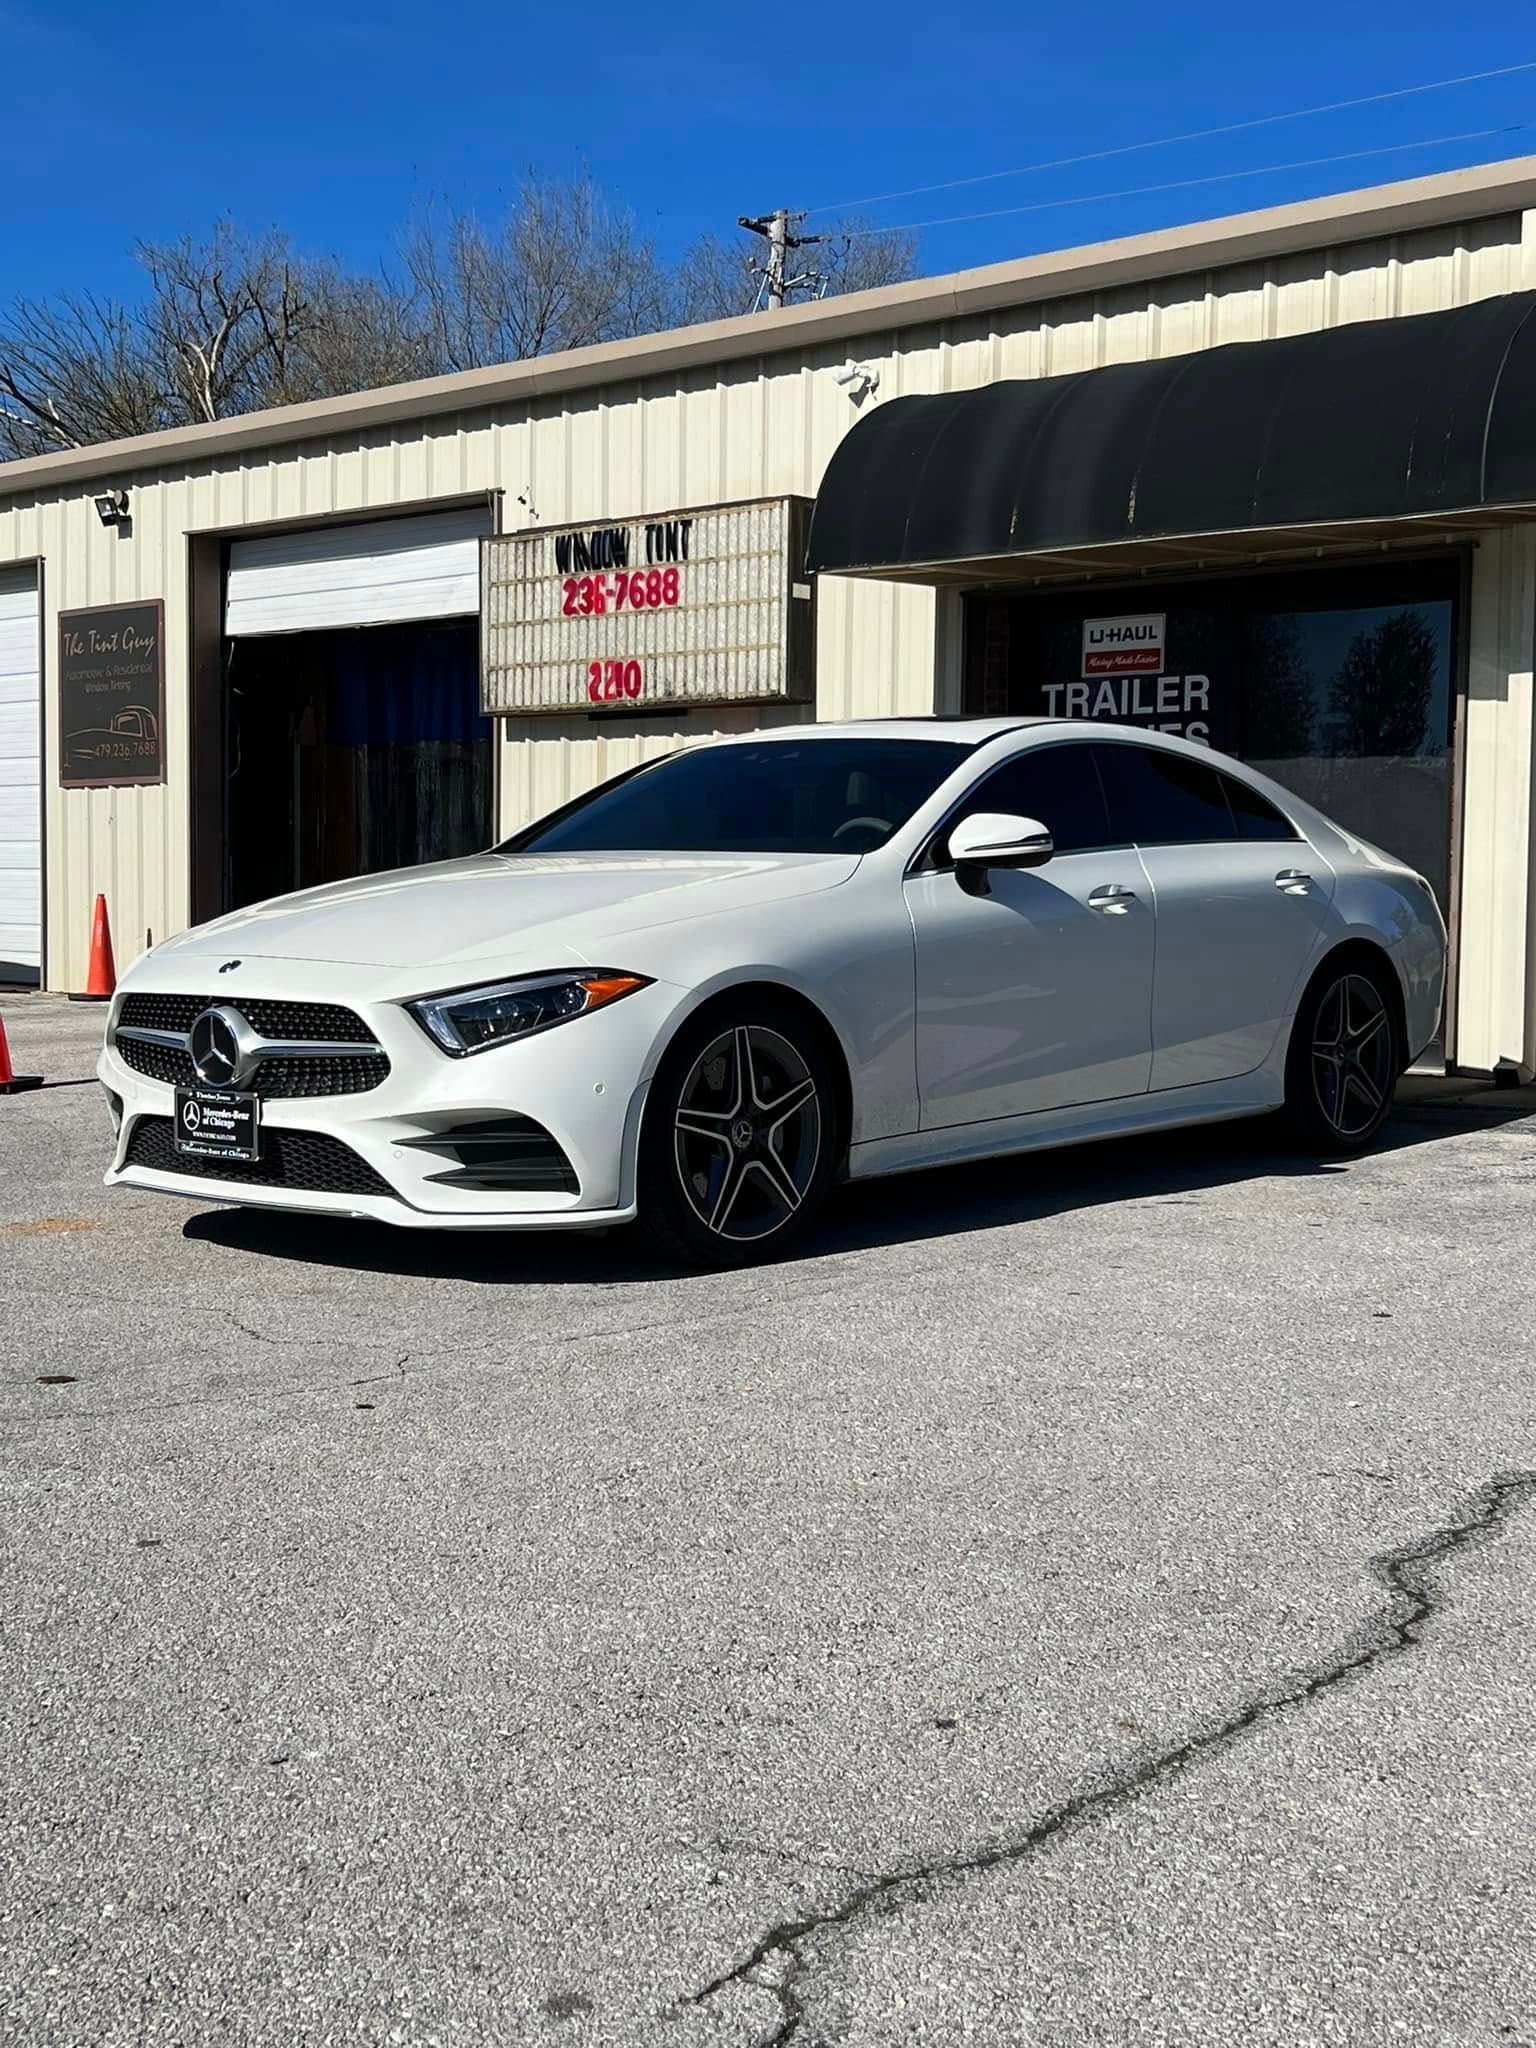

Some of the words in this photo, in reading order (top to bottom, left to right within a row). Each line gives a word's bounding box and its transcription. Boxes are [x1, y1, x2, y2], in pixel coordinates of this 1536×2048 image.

[645, 520, 692, 564] TINT
[563, 568, 679, 616] 236-7688
[64, 631, 85, 656] The
[88, 629, 118, 654] Tint
[122, 626, 156, 657] Guy
[1090, 625, 1158, 644] U-HAUL
[105, 664, 113, 677] &
[589, 660, 642, 702] 2210
[1041, 674, 1210, 718] TRAILER
[95, 741, 157, 758] 479.236.7688
[202, 1117, 209, 1125] of
[210, 1117, 235, 1129] Chicago
[203, 1107, 250, 1120] Mercedes-Benz
